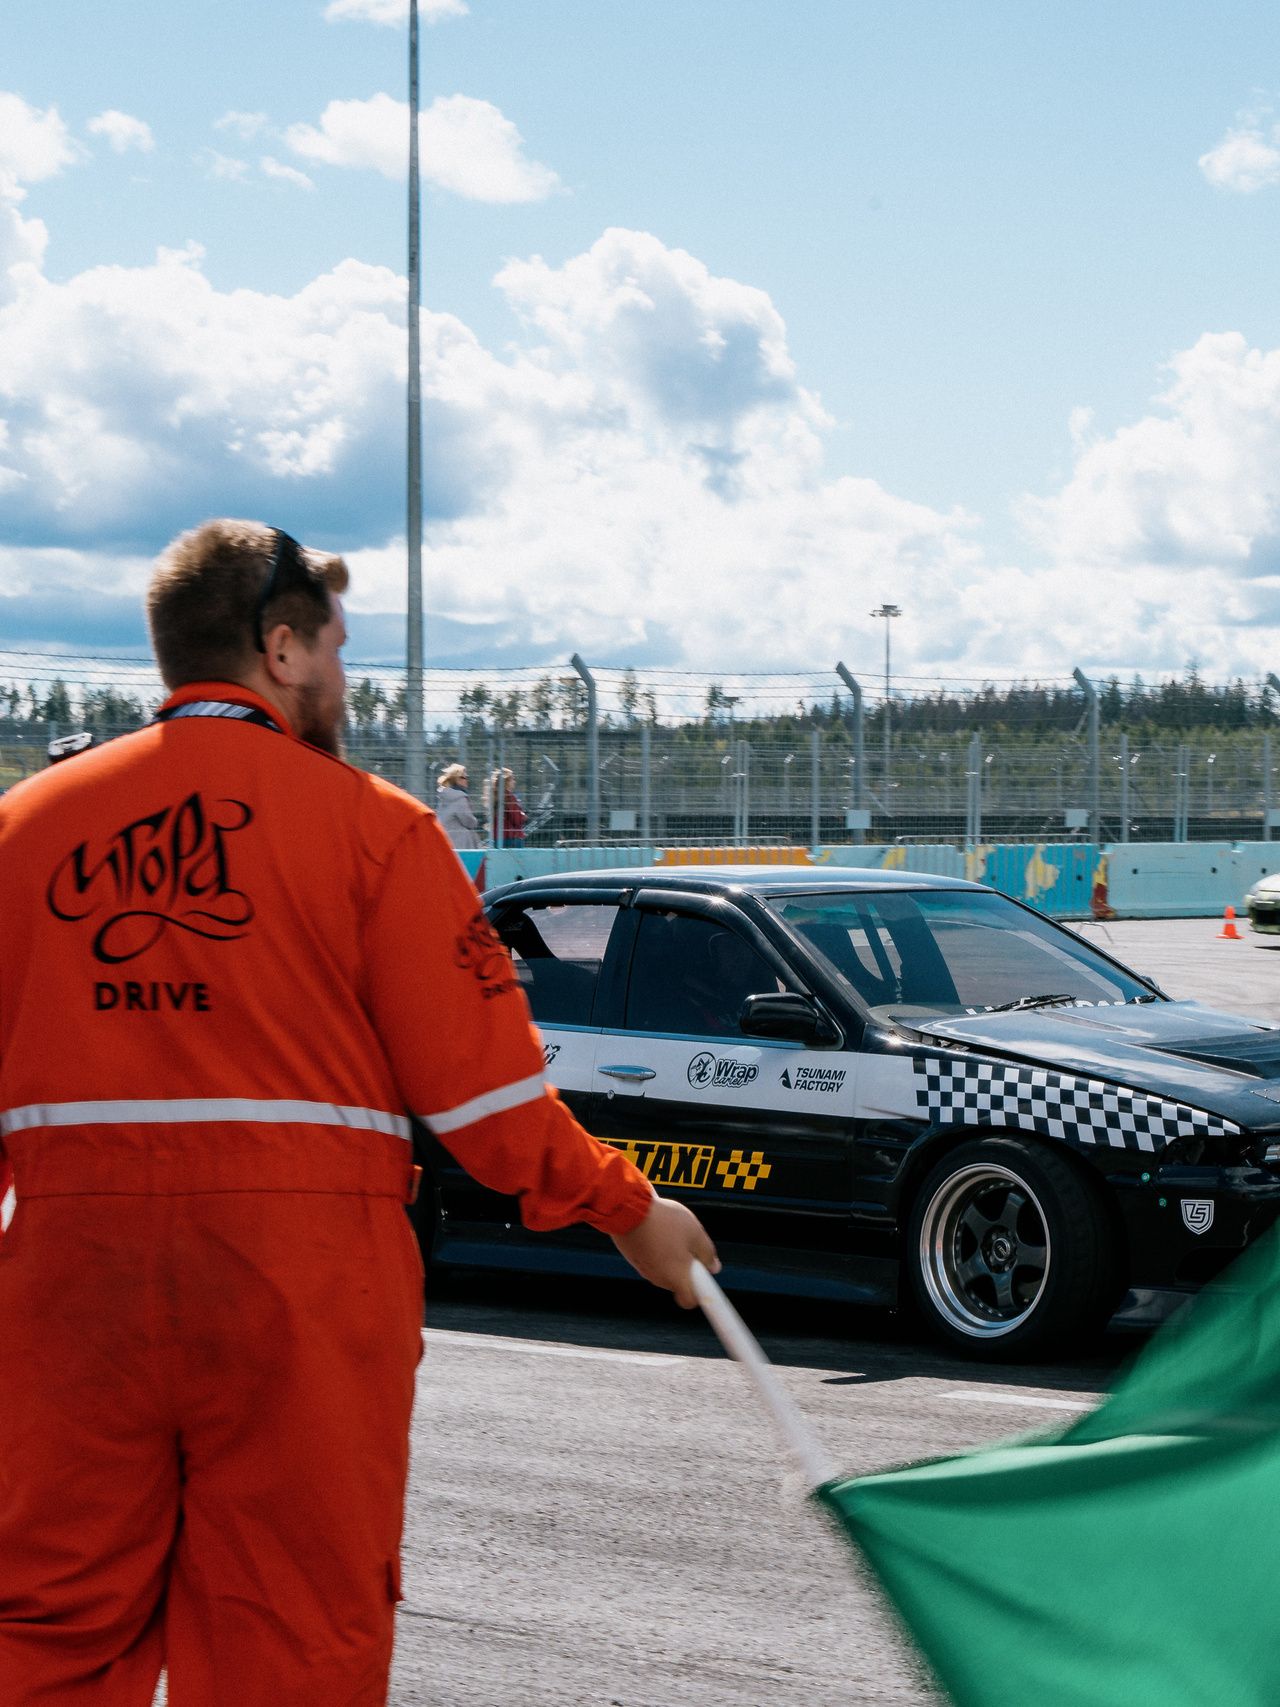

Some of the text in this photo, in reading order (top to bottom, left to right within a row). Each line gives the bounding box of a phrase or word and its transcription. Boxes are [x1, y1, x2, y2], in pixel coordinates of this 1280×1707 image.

[94, 981, 210, 1011] DRIVE
[716, 1060, 757, 1083] Wrap
[796, 1067, 846, 1081] TSUNAMI
[794, 1079, 843, 1092] FACTORY
